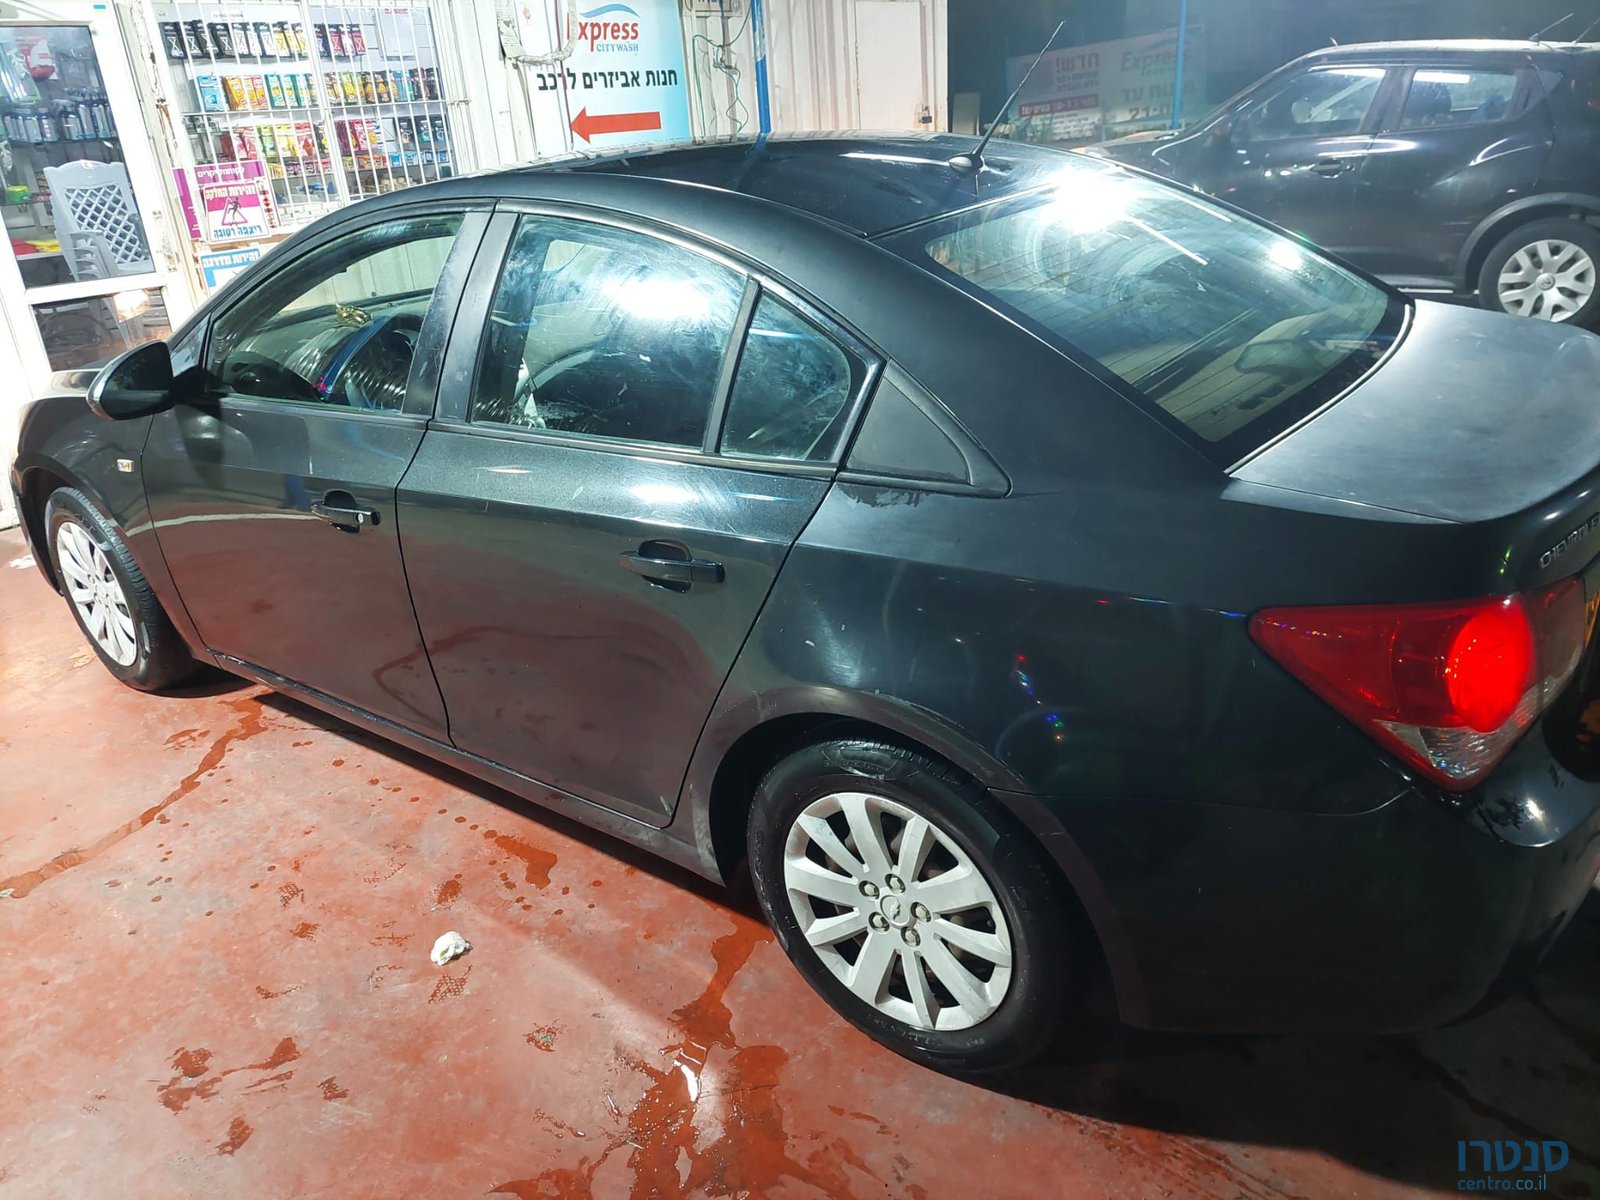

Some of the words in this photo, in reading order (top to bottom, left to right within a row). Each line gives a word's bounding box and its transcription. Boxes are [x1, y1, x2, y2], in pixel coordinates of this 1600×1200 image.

[596, 42, 639, 53] CITYWASH
[582, 70, 641, 89] אביזרים
[645, 69, 678, 87] חנות
[205, 187, 228, 201] החלקה
[228, 184, 255, 197] זהירות
[213, 227, 236, 239] רטובה
[237, 225, 262, 236] ריצפה
